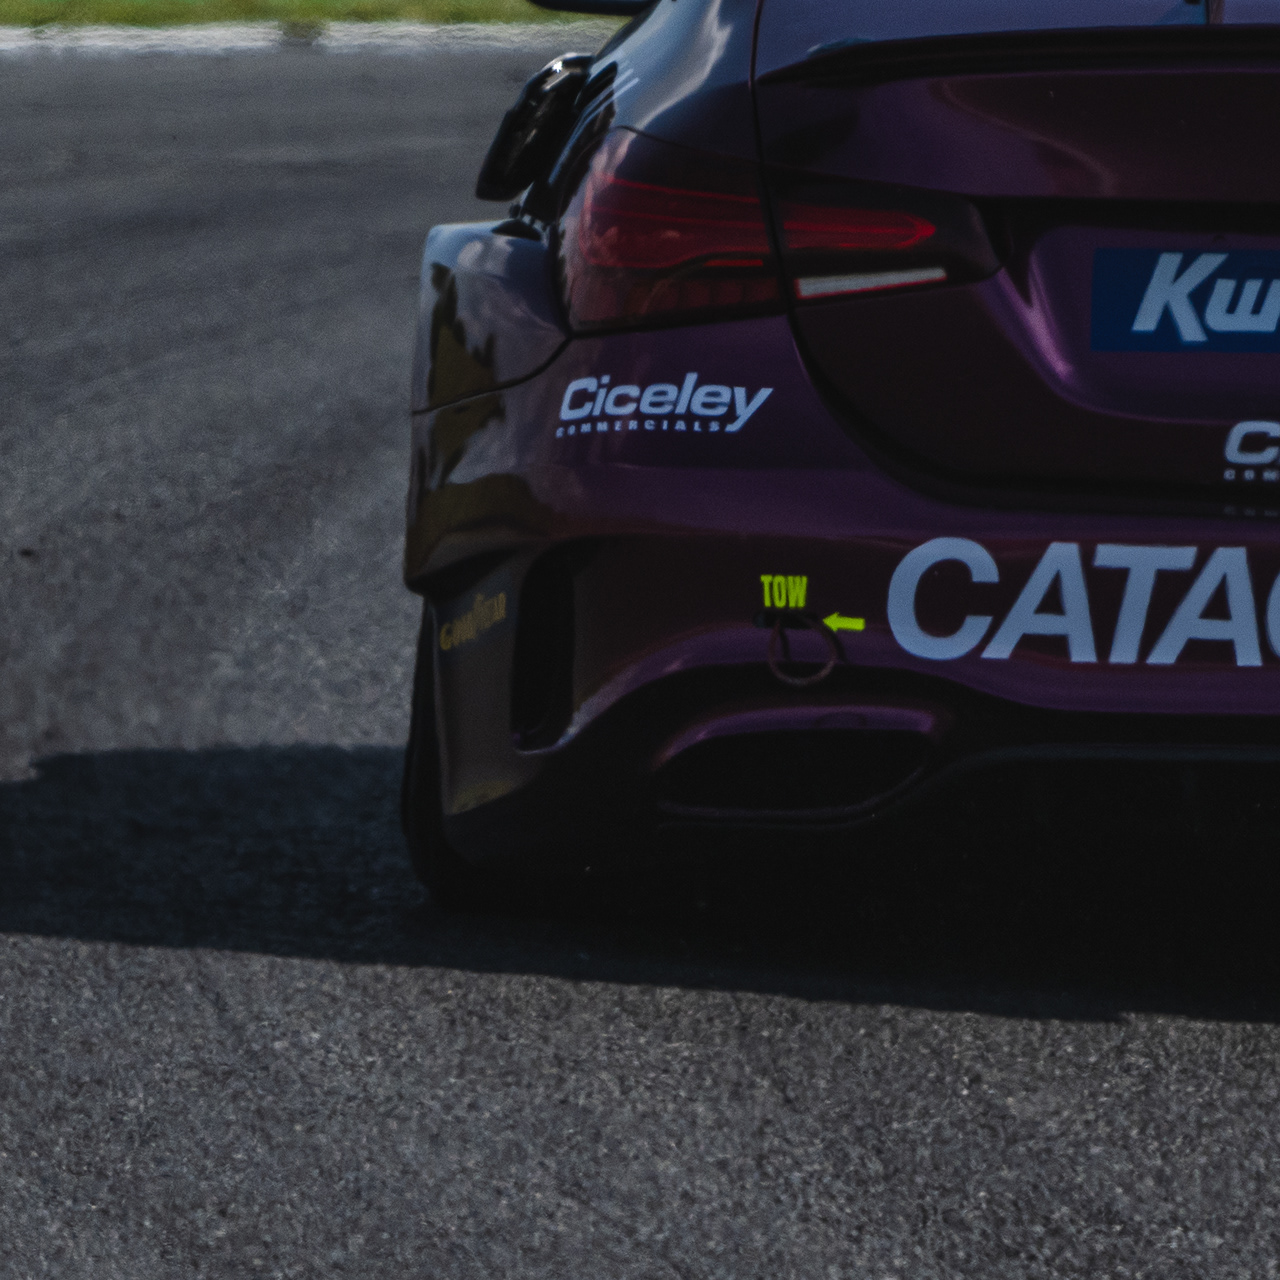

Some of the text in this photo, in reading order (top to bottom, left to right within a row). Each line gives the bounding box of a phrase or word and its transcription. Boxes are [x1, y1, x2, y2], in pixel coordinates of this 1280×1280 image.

[559, 371, 775, 433] Ciceley
[555, 420, 722, 439] COMMERCIALS
[760, 574, 808, 608] TOW
